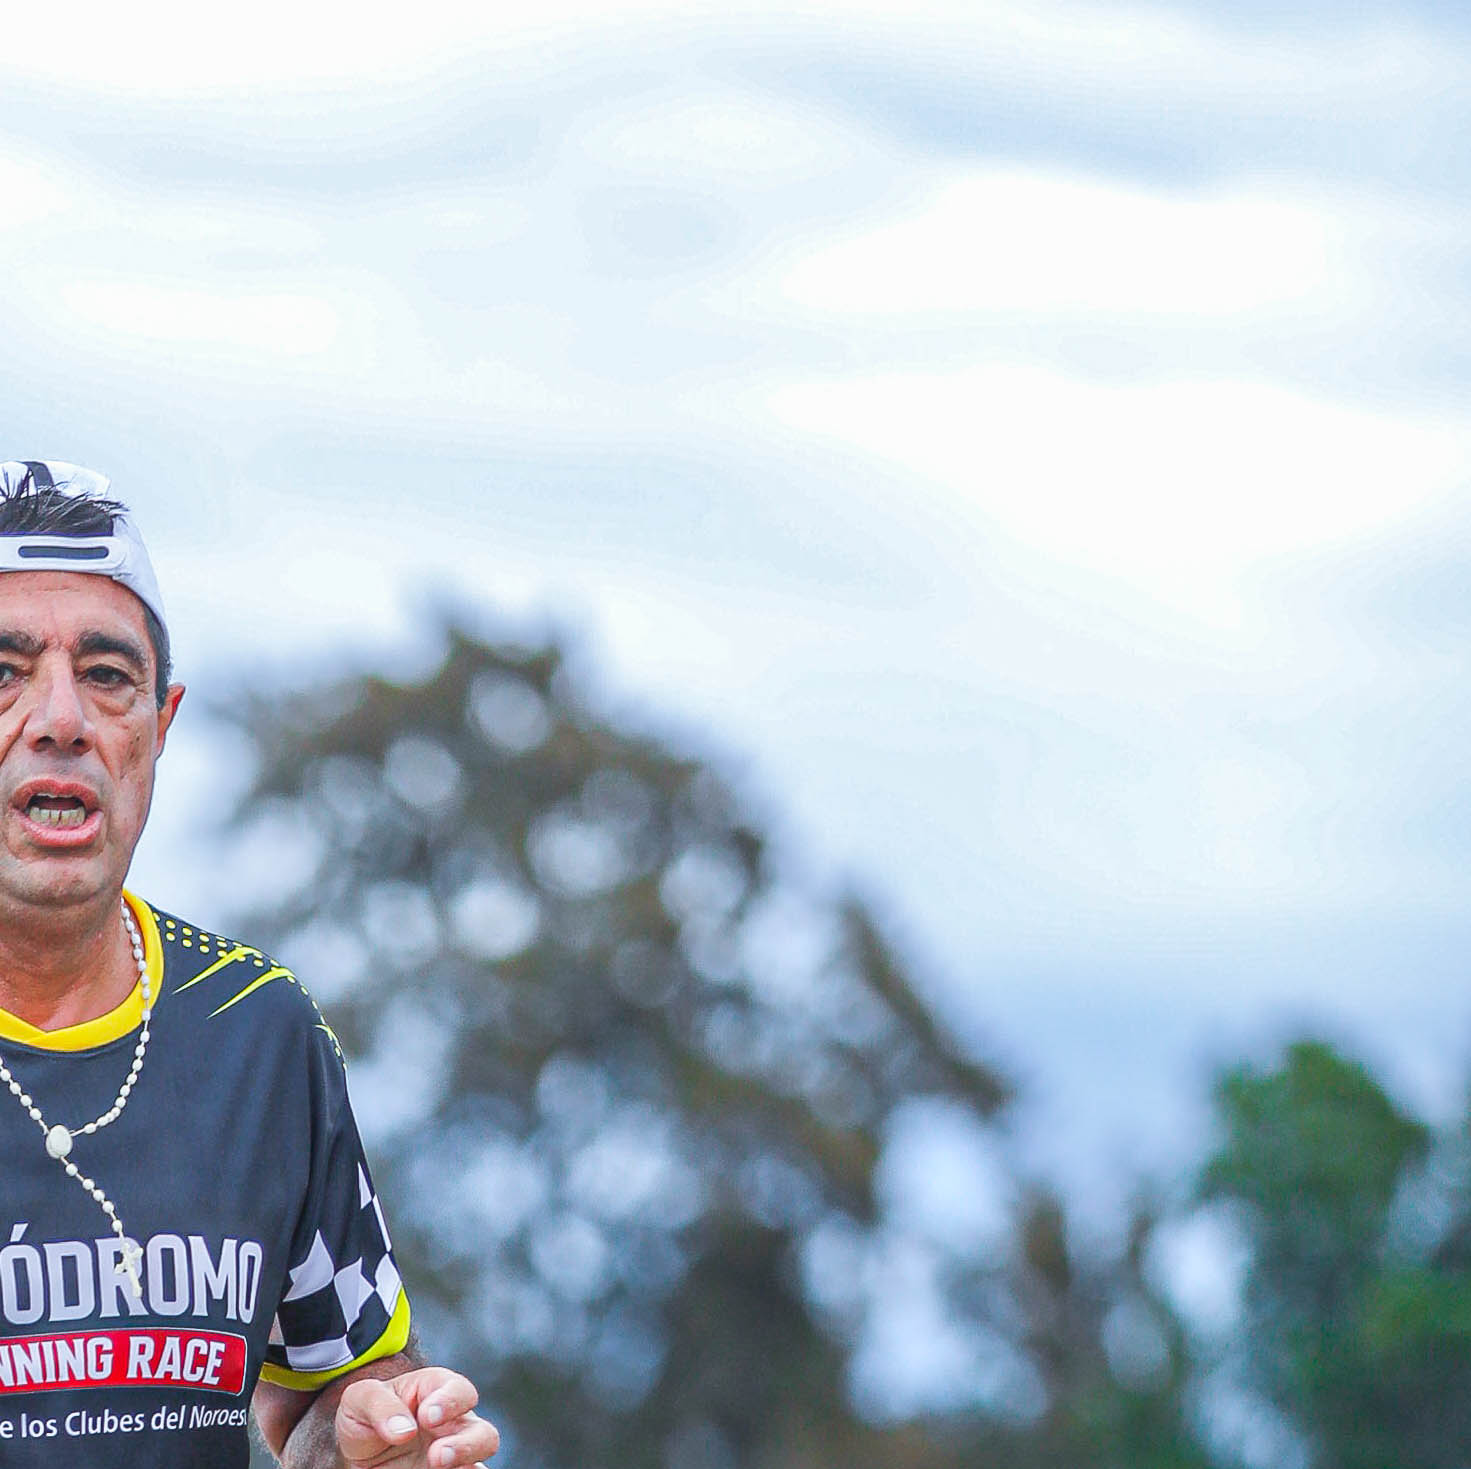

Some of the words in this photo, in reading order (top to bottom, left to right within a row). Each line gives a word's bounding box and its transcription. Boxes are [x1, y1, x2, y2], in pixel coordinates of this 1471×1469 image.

[128, 1335, 226, 1386] RACE
[20, 1413, 58, 1438] los
[64, 1408, 145, 1437] Clubes
[150, 1404, 187, 1431] del
